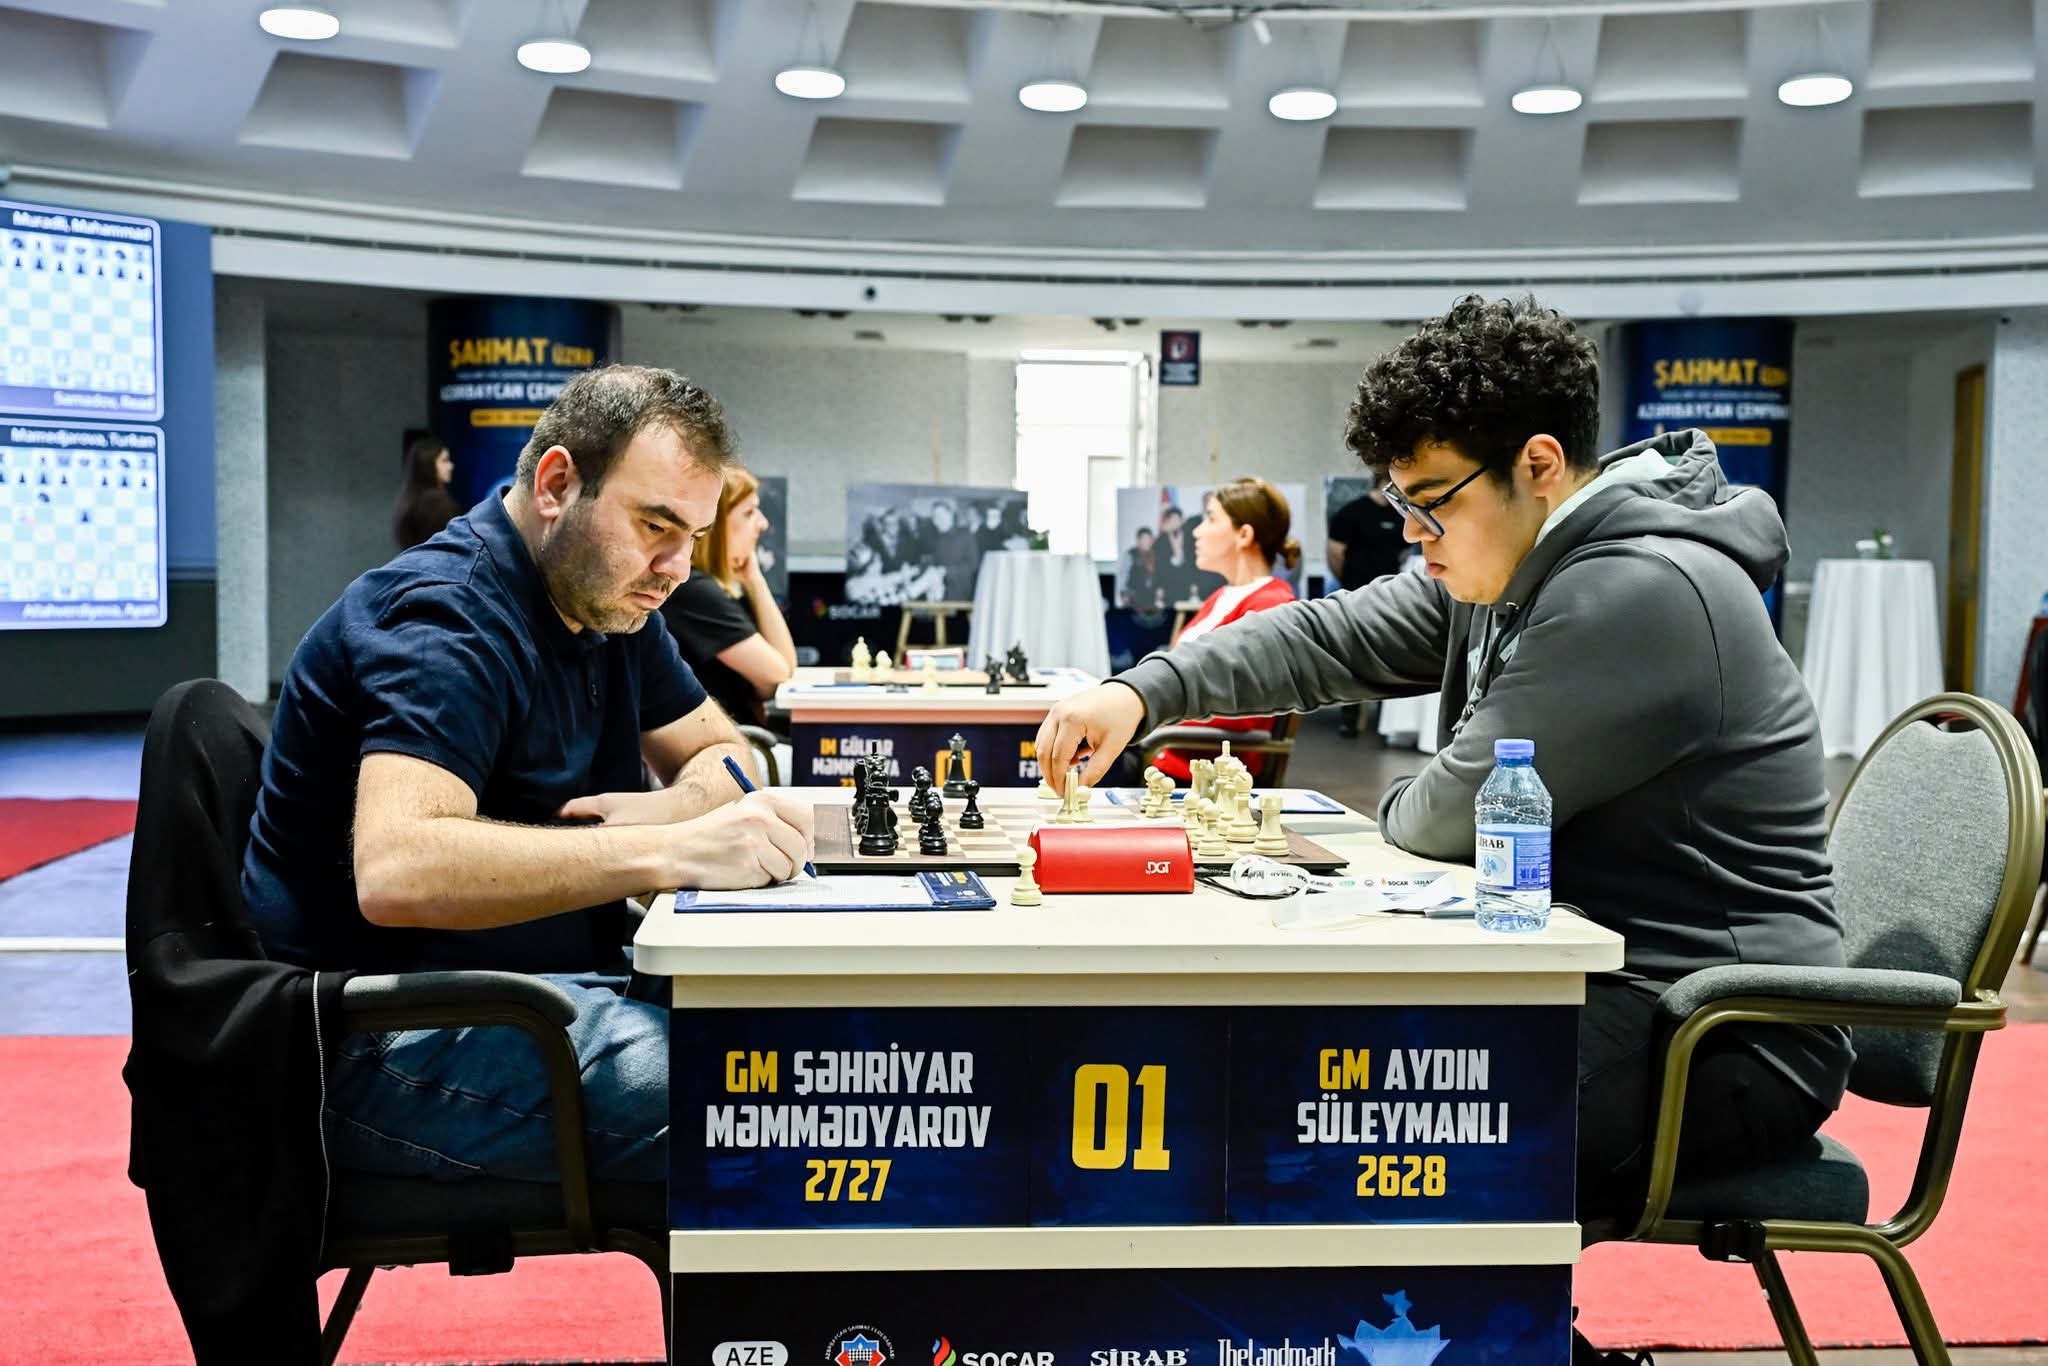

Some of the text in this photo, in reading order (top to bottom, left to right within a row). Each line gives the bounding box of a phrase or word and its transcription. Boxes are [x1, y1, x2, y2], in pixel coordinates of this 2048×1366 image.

[450, 337, 548, 368] ŞAHMAT
[1654, 359, 1757, 389] ŞAHMAT
[1145, 861, 1171, 874] DGT
[726, 1043, 974, 1095] GM ŞƏHRİYAR
[1319, 1049, 1489, 1090] GM AYDIN
[706, 1105, 992, 1147] MƏMMƏDYAROV
[1072, 1063, 1170, 1171] 01
[1297, 1093, 1509, 1144] SÜLEYMANLI
[805, 1159, 891, 1201] 2727
[1356, 1155, 1446, 1197] 2628
[725, 1347, 773, 1366] AZE
[962, 1351, 1055, 1366] SOCAR
